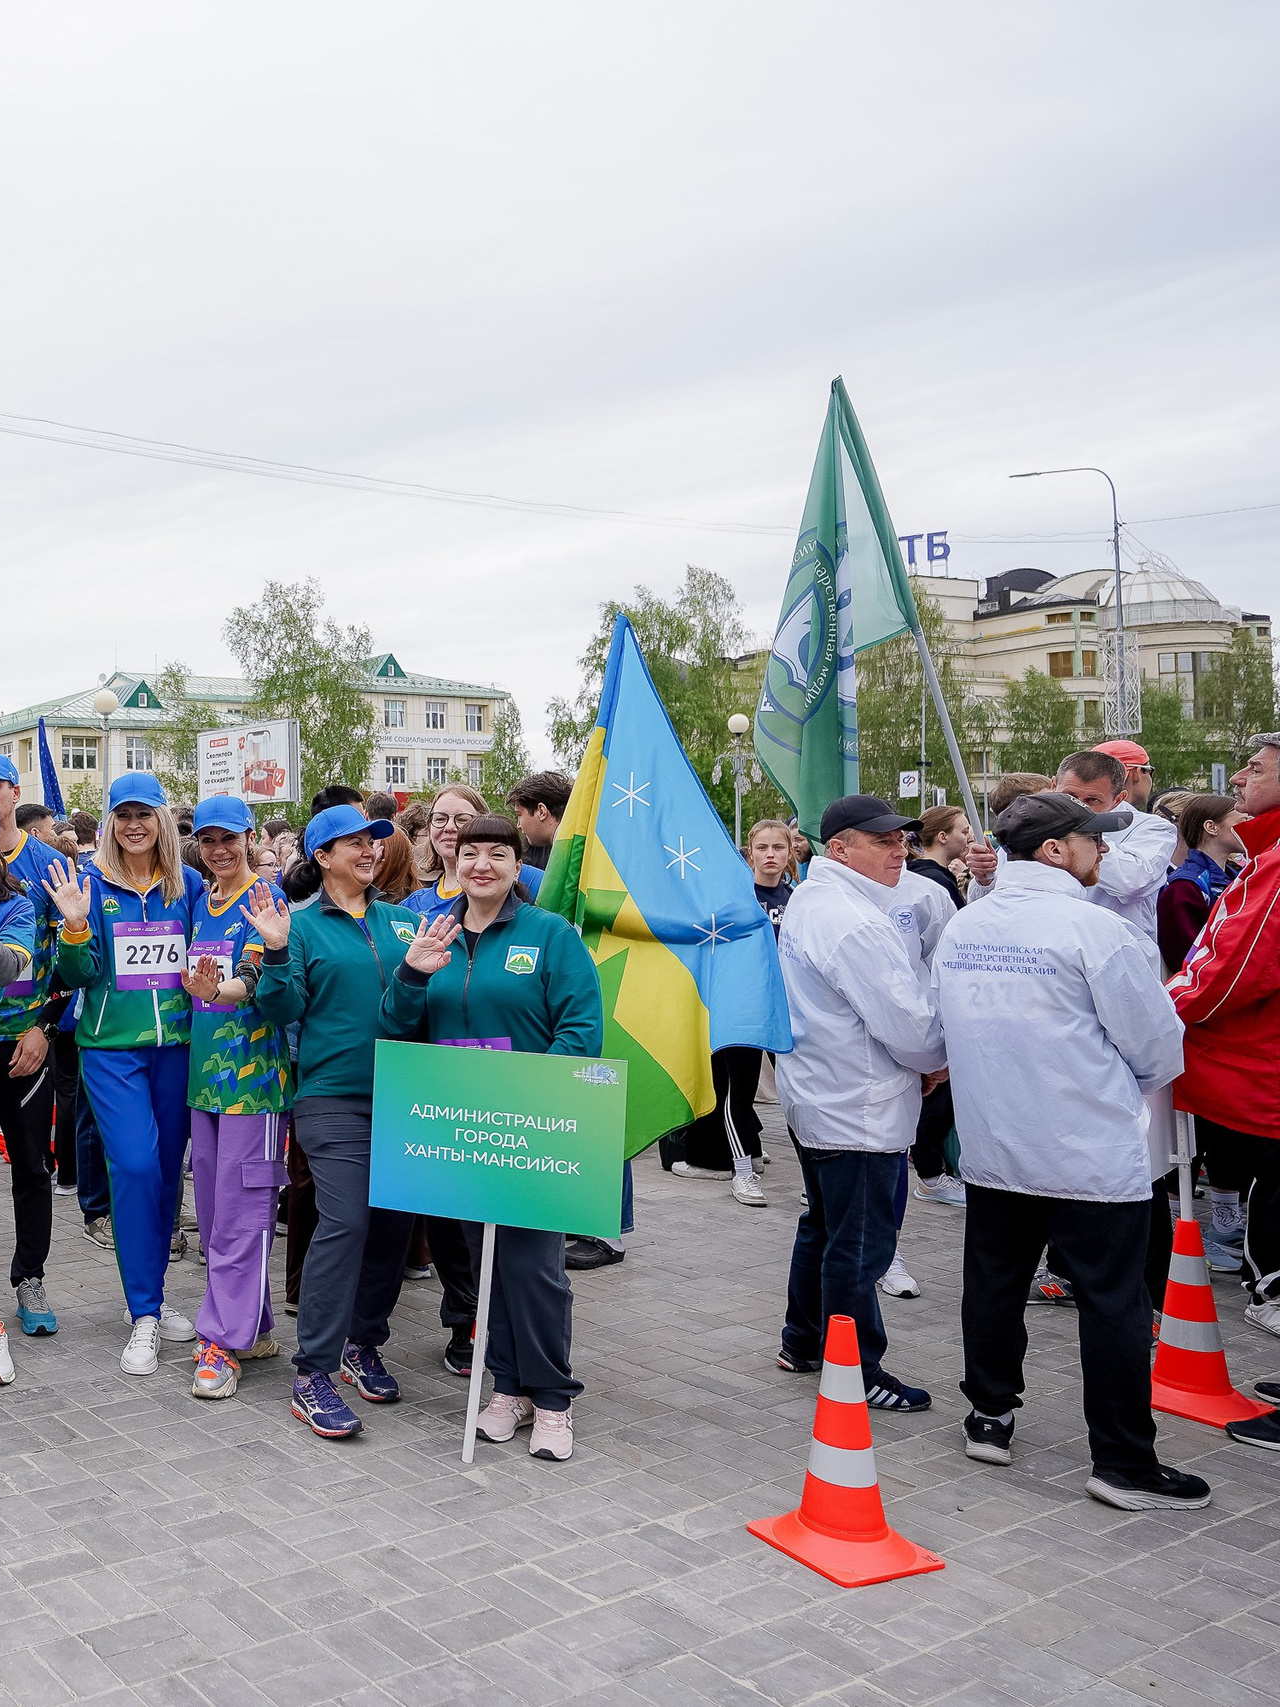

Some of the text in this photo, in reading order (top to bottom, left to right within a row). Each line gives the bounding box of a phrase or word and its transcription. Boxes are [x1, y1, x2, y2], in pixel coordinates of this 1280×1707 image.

[898, 530, 951, 564] ТБ
[393, 735, 441, 745] СОЦИАЛЬНОГО
[442, 737, 466, 746] ФОНДА
[466, 739, 493, 747] РОССИИ
[209, 768, 230, 777] квартир
[125, 943, 179, 965] 2276
[953, 942, 1044, 955] ХАНТЫ-МАНСИЙСКАЯ
[957, 952, 1037, 965] ГОСУДАРСТВЕННАЯ
[942, 961, 1057, 976] МЕДИЦИНСКАЯ АКАДЕМИЯ
[409, 1103, 578, 1133] АДМИНИСТРАЦИЯ
[454, 1128, 529, 1150] ГОРОДА
[403, 1141, 582, 1176] ХАНТЫ-МАНСИЙСК
